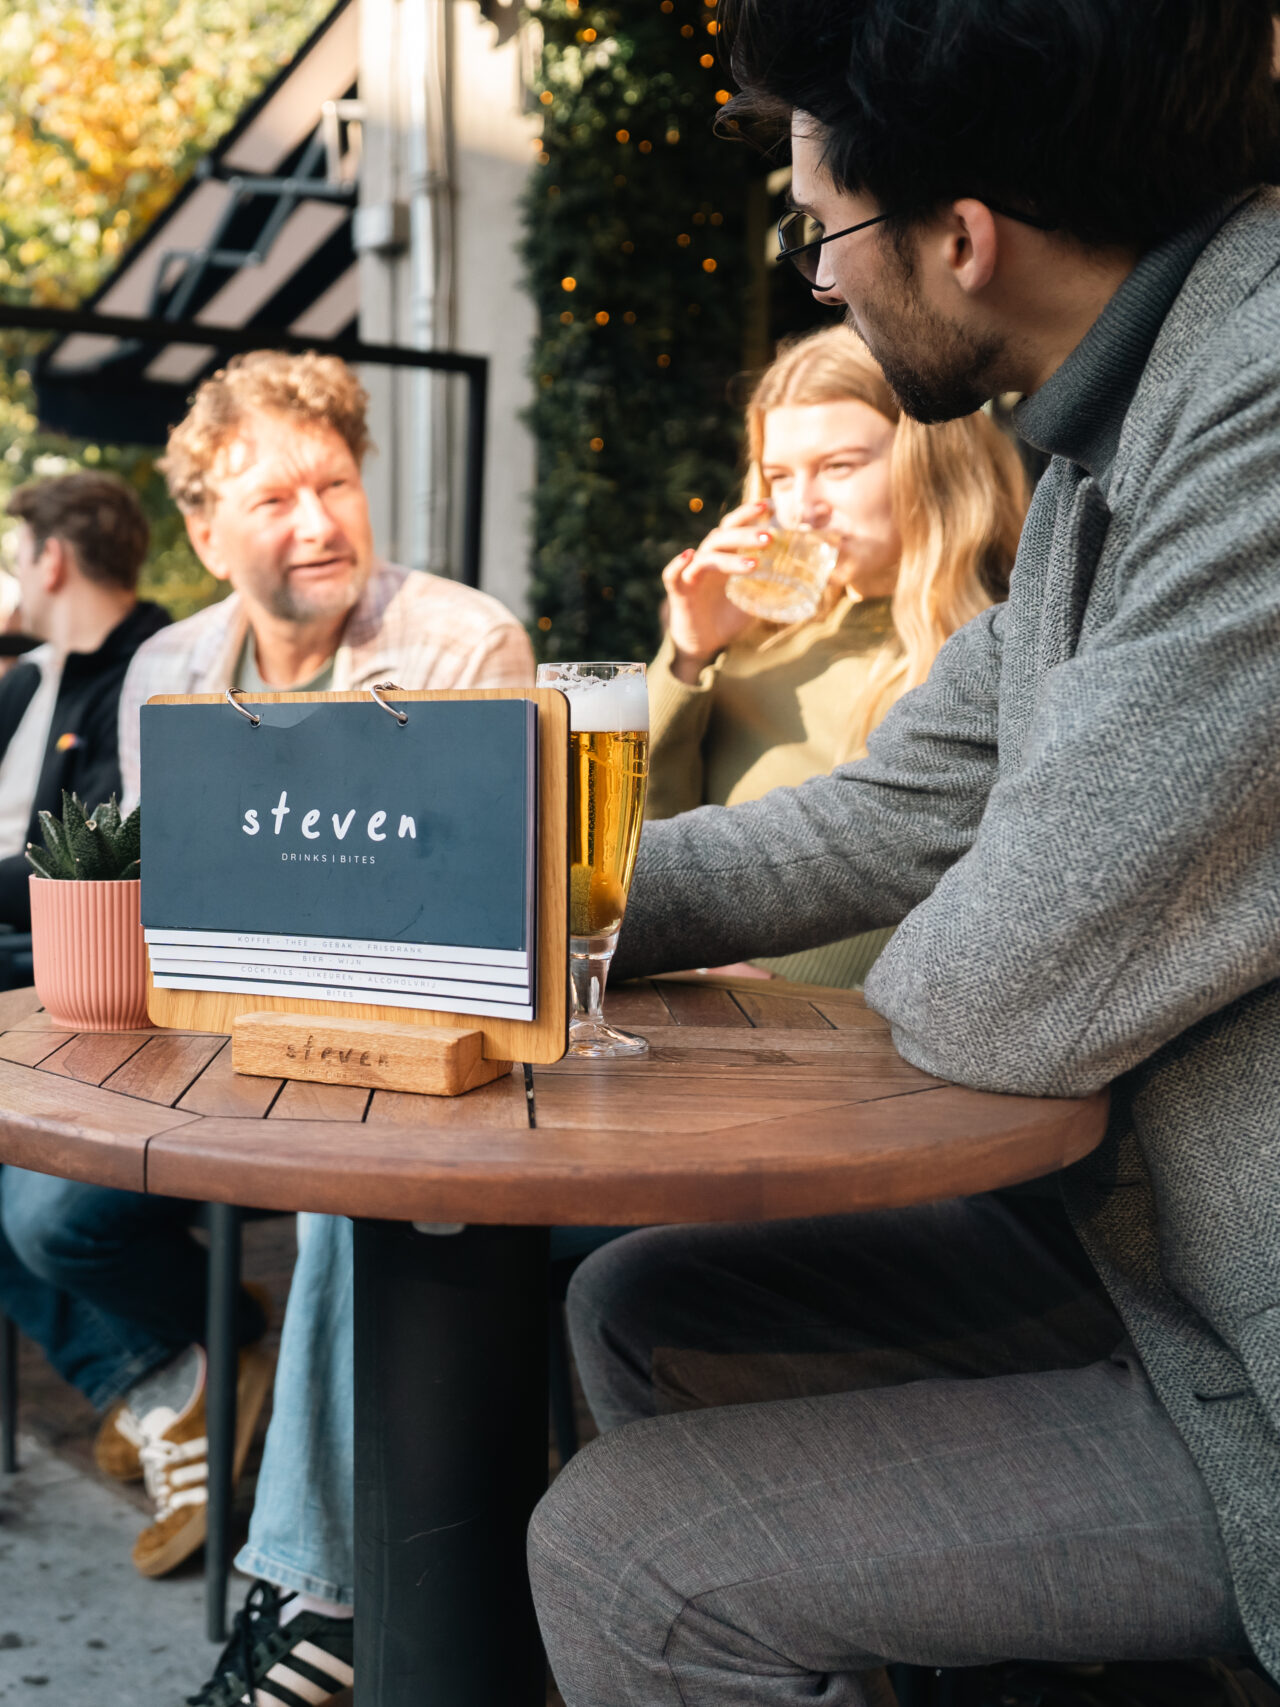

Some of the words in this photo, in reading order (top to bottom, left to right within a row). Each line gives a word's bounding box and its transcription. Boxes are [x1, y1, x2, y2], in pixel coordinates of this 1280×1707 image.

[242, 790, 417, 842] steven
[281, 853, 328, 862] DRINKS
[340, 855, 376, 864] BITES
[237, 936, 272, 945] KOFFIE
[285, 938, 309, 947] THEE
[322, 941, 353, 950] GEBAK
[367, 943, 424, 954] FRISDRANK
[302, 955, 325, 963] BIER
[337, 958, 362, 966] WIJN
[241, 966, 294, 976] COCKTAILS
[306, 971, 354, 981] LIKEUREN
[367, 976, 438, 989] ALCOHOLVRIJ
[326, 989, 354, 998] BITES
[286, 1034, 390, 1067] steven
